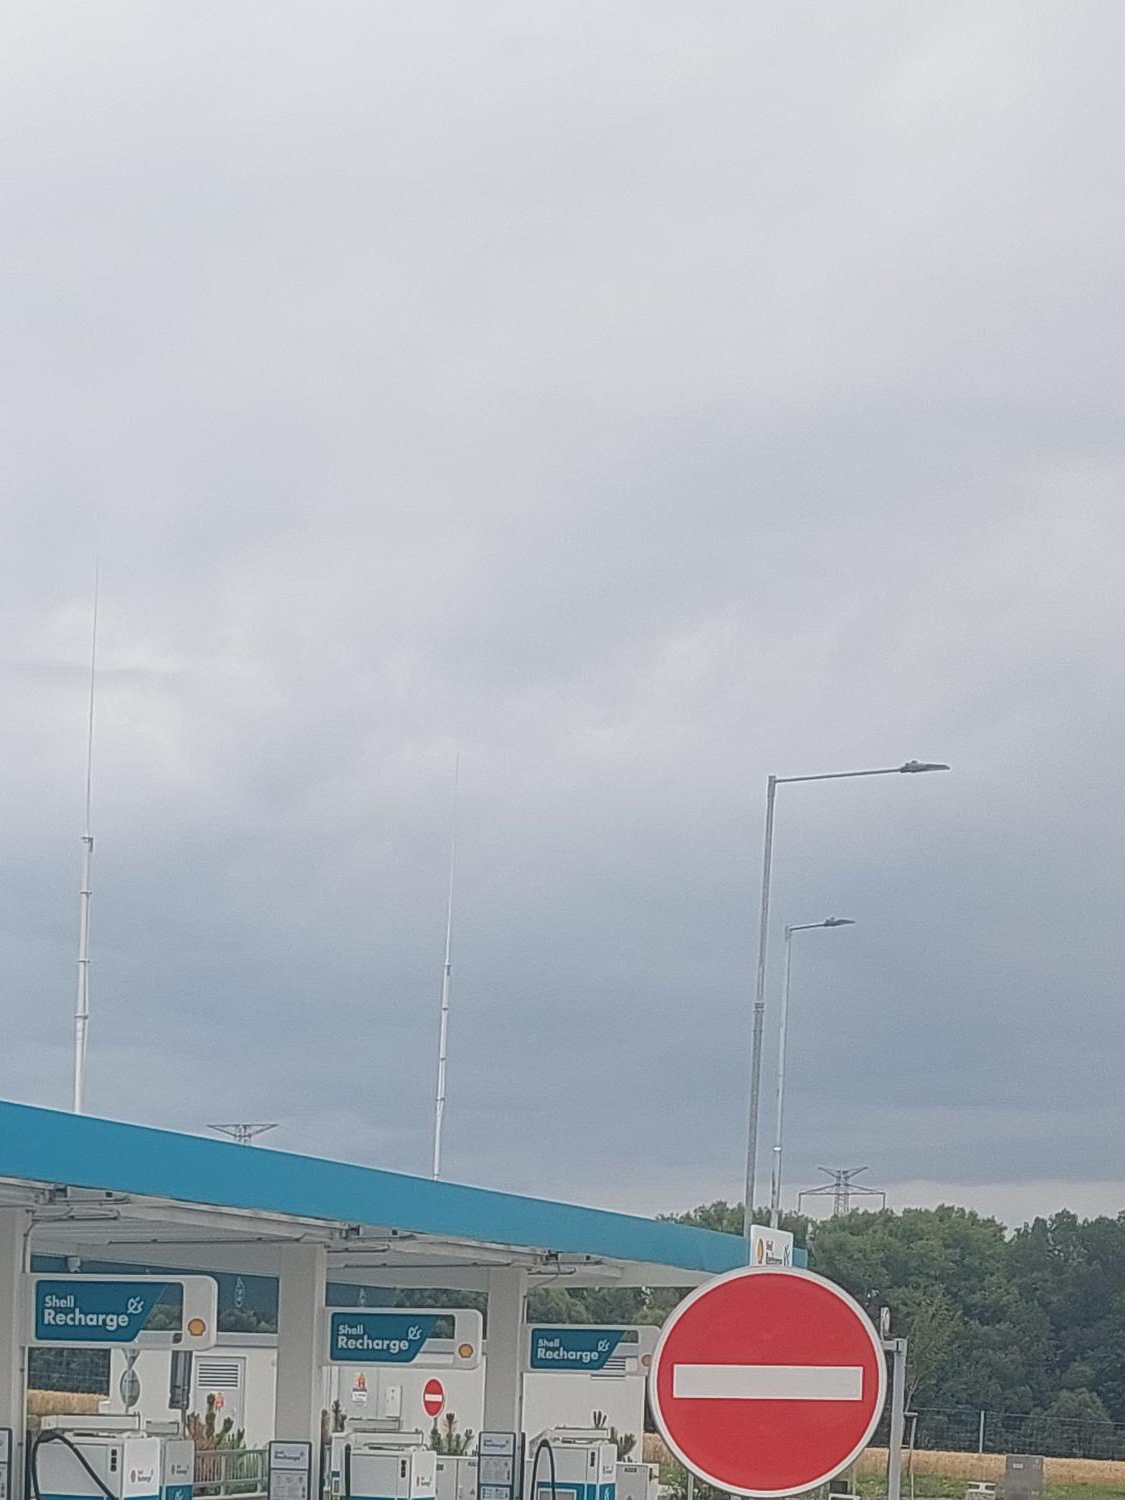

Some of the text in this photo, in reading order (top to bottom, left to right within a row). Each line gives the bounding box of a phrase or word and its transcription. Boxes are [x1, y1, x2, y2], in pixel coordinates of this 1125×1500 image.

[44, 1295, 75, 1308] Shell
[43, 1307, 130, 1331] Recharge
[338, 1324, 364, 1335] Shell
[338, 1334, 410, 1354] Recharge
